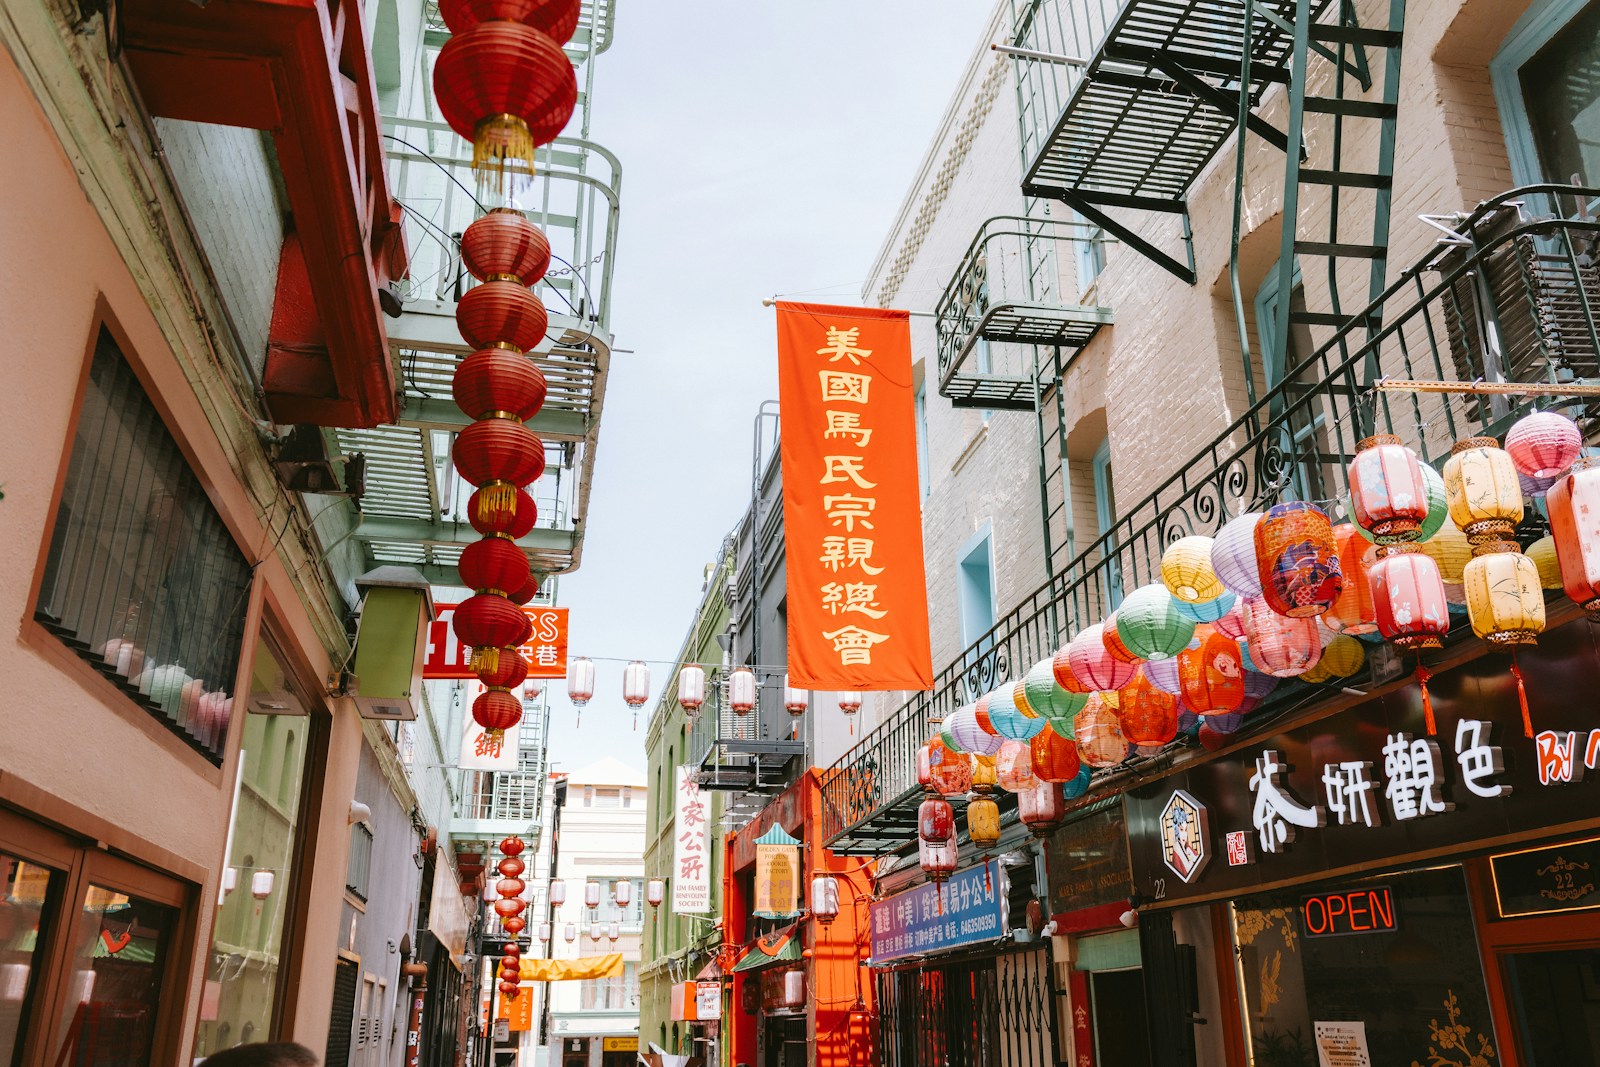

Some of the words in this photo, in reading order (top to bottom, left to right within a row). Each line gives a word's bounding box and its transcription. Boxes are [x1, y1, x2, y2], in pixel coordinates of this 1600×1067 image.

[816, 325, 890, 665] 美國馬氏宗親總會
[1154, 878, 1166, 899] 22
[1555, 873, 1574, 889] 22
[1305, 889, 1393, 934] OPEN
